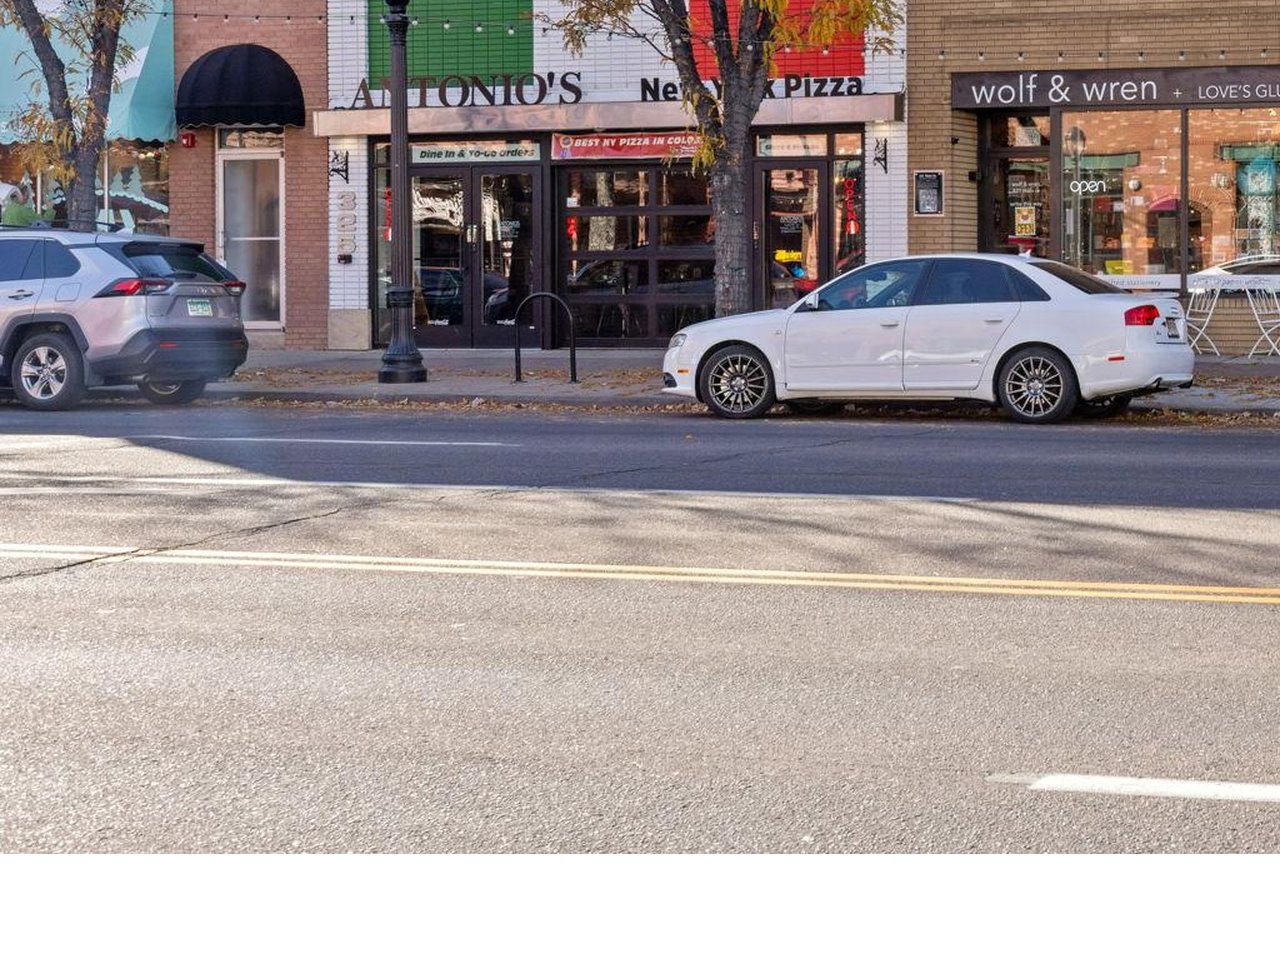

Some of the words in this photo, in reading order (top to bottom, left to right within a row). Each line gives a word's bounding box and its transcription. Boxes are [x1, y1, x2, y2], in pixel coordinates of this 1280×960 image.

[641, 77, 684, 102] Ne
[785, 74, 863, 99] Pizza
[971, 74, 1038, 104] wolf
[1048, 75, 1070, 103] &
[1082, 80, 1157, 101] wren
[1198, 85, 1251, 99] LOVE'S
[574, 138, 600, 147] BEST
[602, 138, 616, 147] NY
[620, 137, 650, 146] PIZZA
[653, 137, 665, 145] IN
[419, 150, 443, 159] Dine
[444, 150, 456, 158] In
[457, 149, 466, 158] &
[1070, 180, 1107, 195] open
